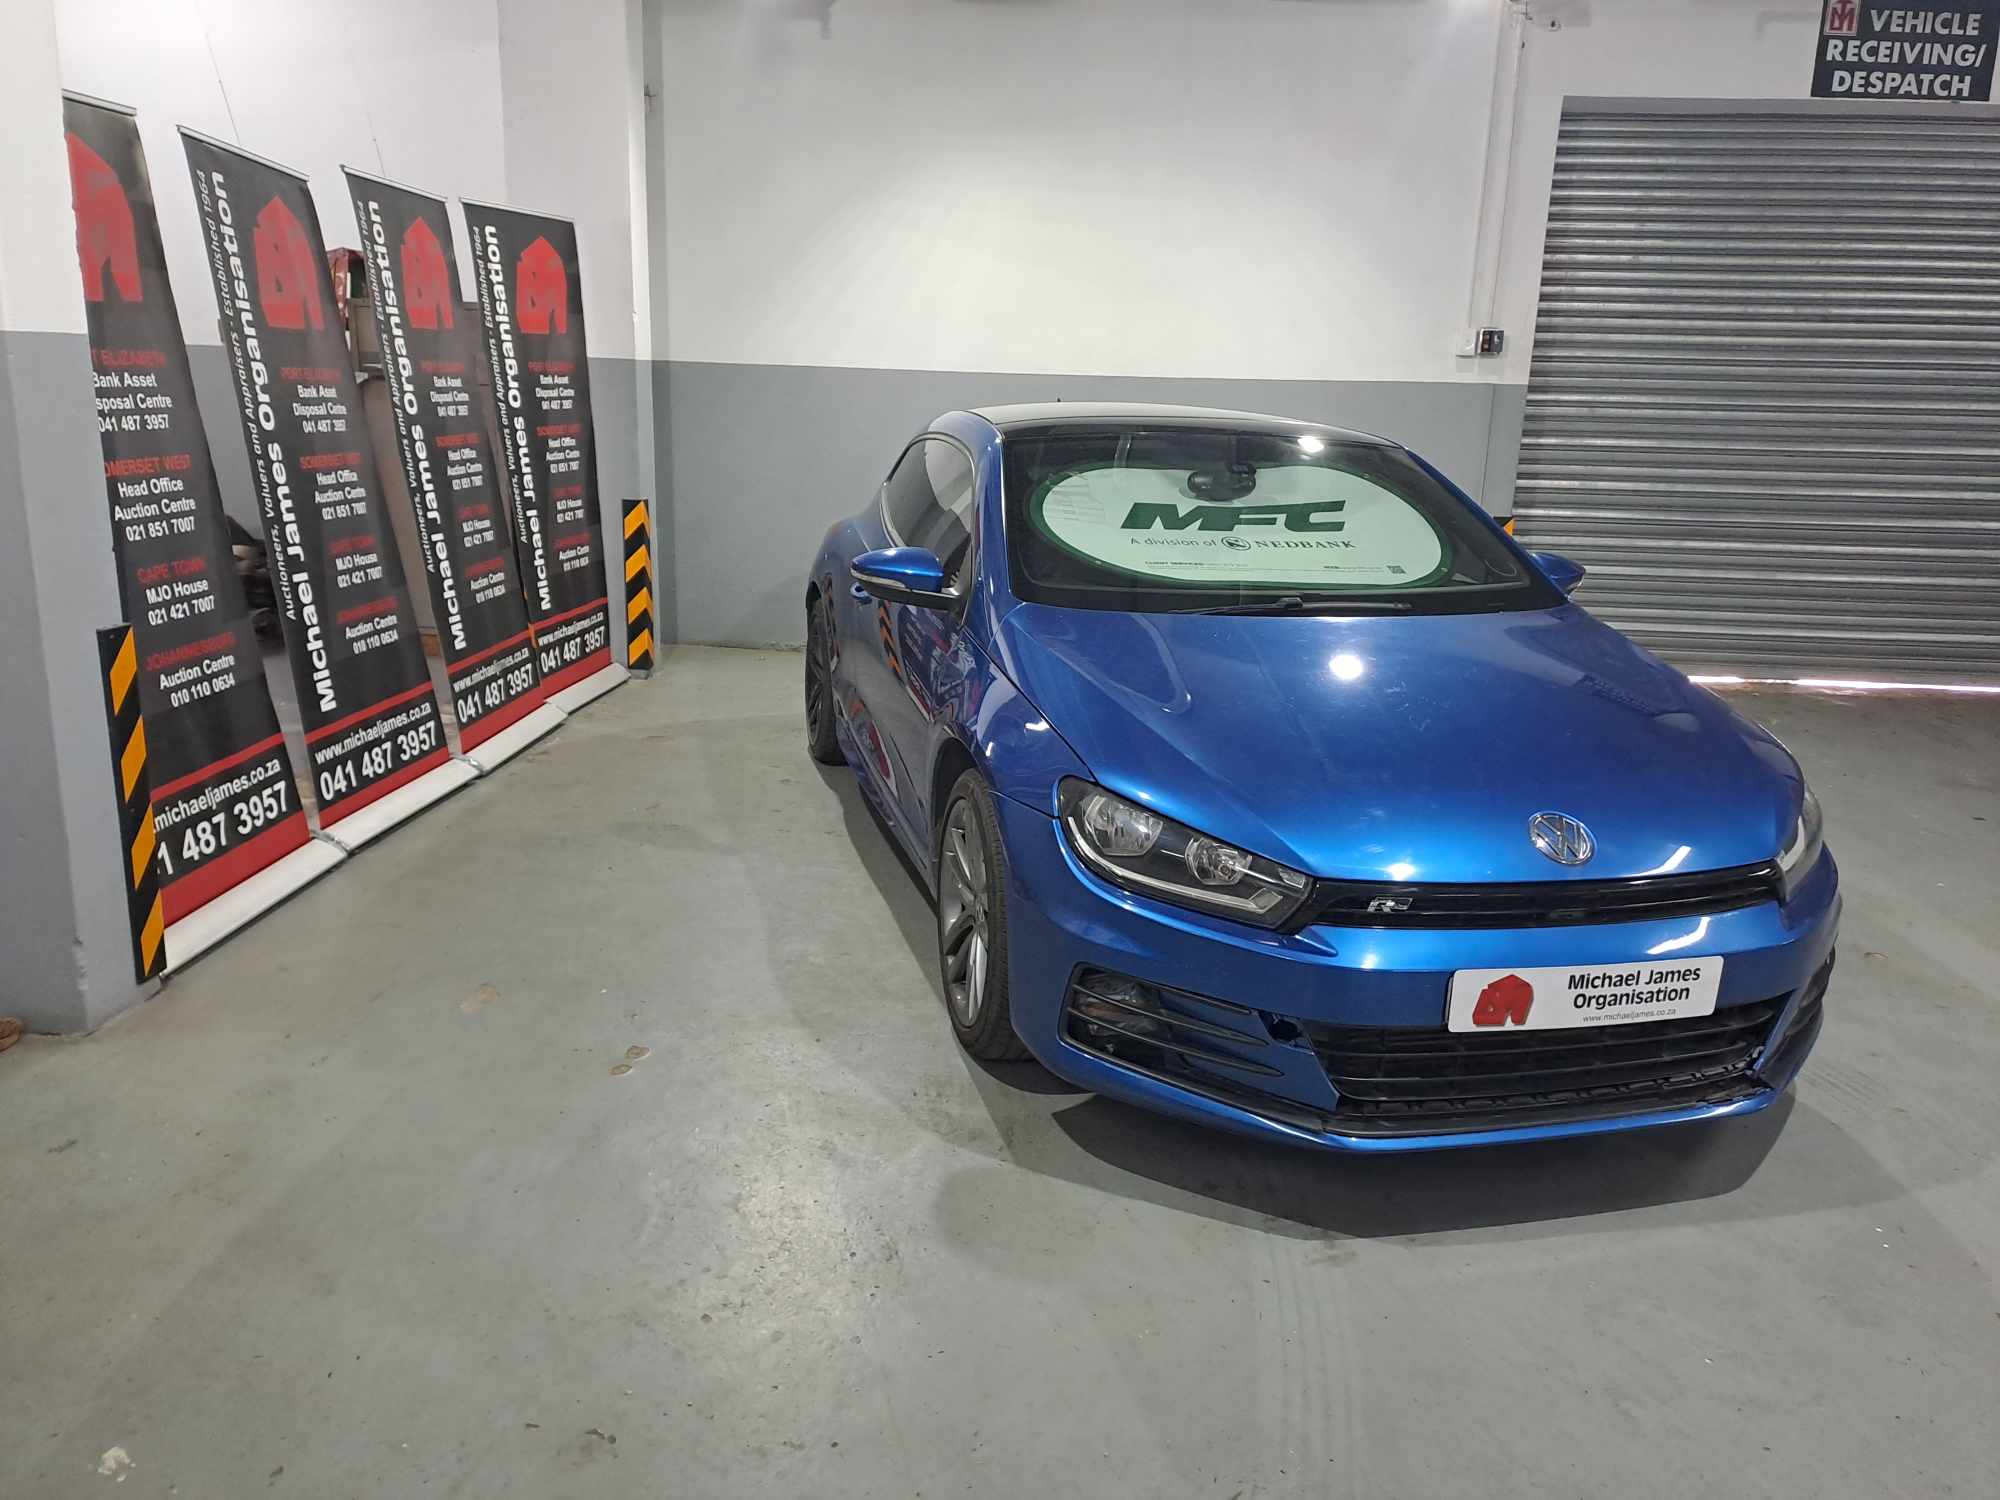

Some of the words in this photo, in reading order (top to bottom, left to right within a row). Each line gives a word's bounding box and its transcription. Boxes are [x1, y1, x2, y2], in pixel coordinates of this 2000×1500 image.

[1870, 9, 1982, 36] VEHICLE
[1826, 39, 1987, 68] RECEIVING/
[1831, 70, 1972, 97] DESPATCH
[196, 169, 213, 213] 1964
[205, 216, 234, 317] Established
[211, 171, 275, 431] Organisation
[368, 200, 418, 415] Organisation
[484, 225, 521, 408] Organisation
[93, 371, 121, 388] Bank
[124, 371, 157, 388] Asset
[297, 385, 318, 398] Bank
[96, 394, 135, 413] sposal
[136, 393, 173, 409] Centre
[292, 402, 327, 418] Disposal
[98, 416, 118, 433] 041
[121, 414, 141, 431] 487
[145, 413, 169, 430] 3957
[247, 422, 262, 455] and
[411, 424, 441, 525] James
[514, 416, 536, 502] James
[117, 480, 149, 499] Head
[149, 477, 184, 495] Office
[257, 459, 275, 518] Valuers
[316, 471, 336, 486] Head
[114, 502, 160, 521] Auction
[161, 497, 197, 514] Centre
[268, 442, 304, 562] James
[315, 488, 344, 504] Auction
[322, 506, 336, 520] 021
[1120, 500, 1346, 532] MFC
[125, 524, 147, 542] 021
[147, 520, 170, 538] 851
[171, 516, 195, 534] 7007
[1144, 537, 1200, 546] division
[1203, 539, 1217, 547] of
[1255, 540, 1357, 550] NEDBANK
[353, 553, 378, 567] House
[526, 509, 552, 611] Michael
[146, 584, 172, 605] MJO
[173, 579, 208, 598] House
[337, 573, 352, 588] 021
[430, 533, 467, 651] Michael
[147, 608, 169, 626] 021
[170, 601, 191, 620] 421
[191, 595, 216, 614] 7007
[292, 571, 337, 713] Michael
[345, 621, 374, 640] Auction
[374, 614, 398, 631] Centre
[540, 646, 561, 673] 041
[563, 637, 581, 662] 487
[584, 625, 605, 653] 3957
[160, 666, 202, 690] Auction
[203, 654, 235, 675] Centre
[170, 689, 190, 708] 010
[190, 681, 212, 701] 110
[212, 672, 236, 693] 0634
[457, 690, 483, 723] 041
[485, 678, 507, 708] 487
[507, 663, 533, 696] 3957
[315, 702, 432, 766] www.michaeljames.co.za
[319, 760, 358, 801] 041
[361, 741, 393, 779] 487
[397, 719, 437, 762] 3957
[182, 812, 227, 861] 487
[233, 780, 287, 835] 3957
[1567, 969, 1640, 990] Michael
[1646, 966, 1701, 985] James
[1573, 986, 1690, 1012] Organisation
